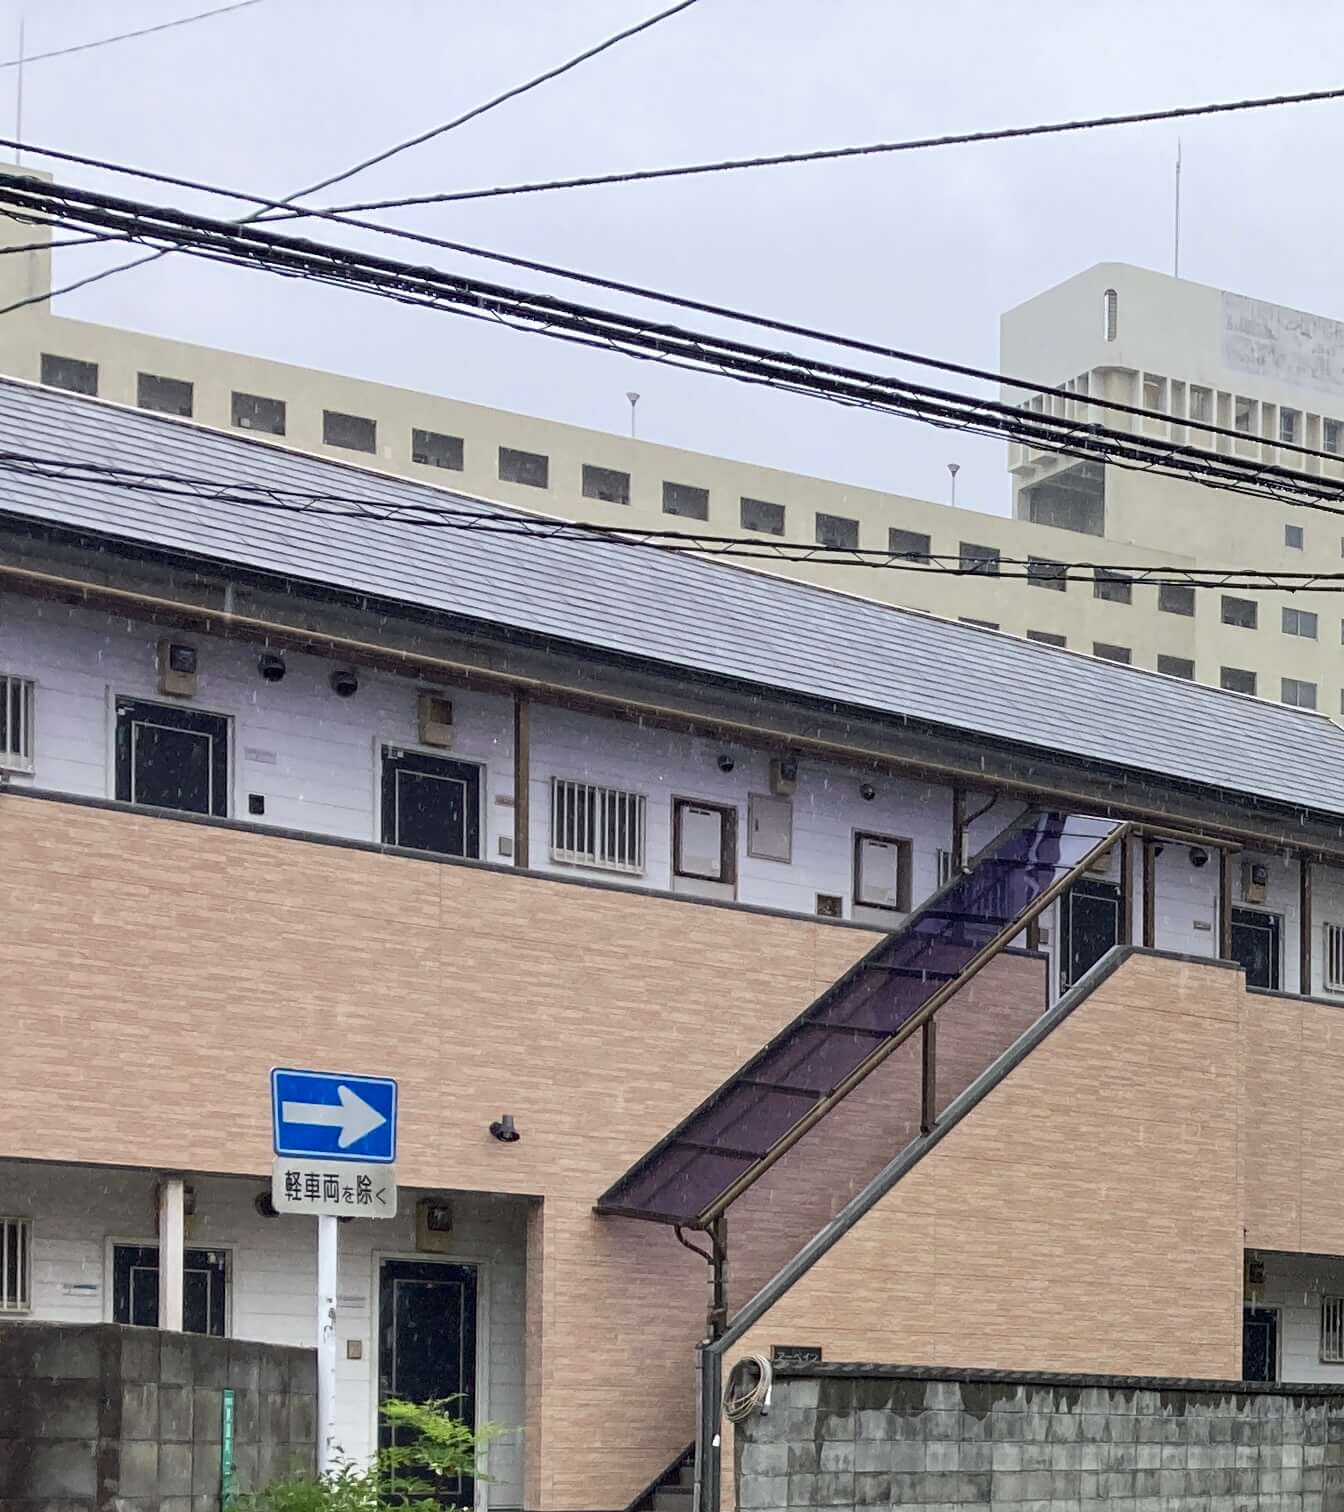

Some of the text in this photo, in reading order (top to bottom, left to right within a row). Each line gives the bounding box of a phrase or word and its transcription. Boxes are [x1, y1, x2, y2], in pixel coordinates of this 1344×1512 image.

[284, 1169, 388, 1206] 軽車両を除く
